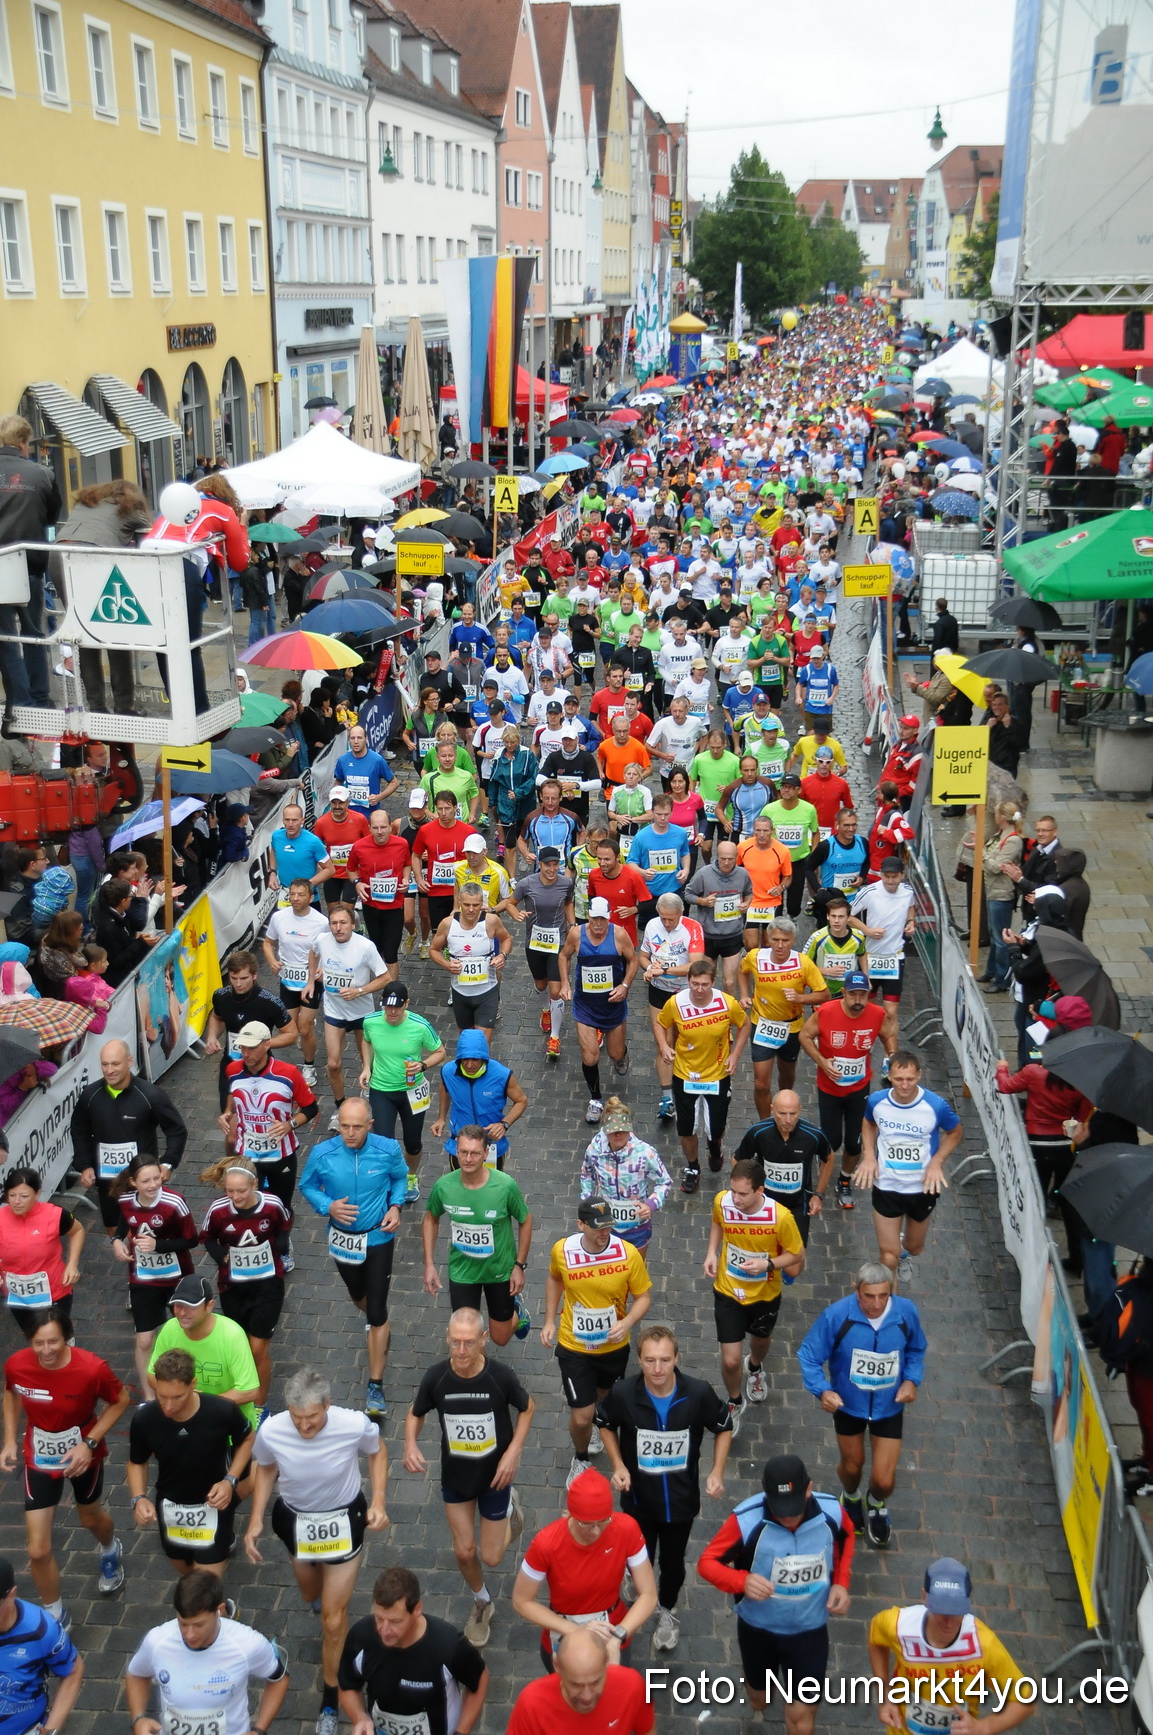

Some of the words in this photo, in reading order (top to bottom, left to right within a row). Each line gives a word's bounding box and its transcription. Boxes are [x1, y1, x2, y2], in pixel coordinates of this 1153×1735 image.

[671, 201, 683, 267] HOTEL
[500, 487, 513, 504] A
[860, 510, 874, 527] A
[400, 551, 441, 562] Schnupper-
[413, 560, 427, 568] lauf
[846, 574, 888, 585] Schnupper-
[860, 581, 874, 590] lauf
[628, 678, 640, 686] 249
[810, 693, 827, 701] 2777
[936, 748, 986, 763] Jugend-
[761, 766, 782, 775] 2831
[949, 762, 973, 774] lauf
[778, 832, 801, 840] 2028
[654, 856, 672, 865] 116
[373, 883, 395, 893] 2302
[723, 902, 735, 912] 53
[536, 932, 555, 944] 395
[463, 963, 483, 975] 481
[871, 959, 896, 969] 2903
[284, 968, 306, 981] 3089
[587, 972, 607, 983] 388
[780, 973, 804, 983] BÖGL
[326, 975, 353, 988] 2707
[682, 1021, 704, 1031] MAX
[706, 1014, 730, 1026] BÖGL
[759, 1022, 787, 1039] 2999
[835, 1063, 863, 1076] 2897
[244, 1113, 271, 1123] BIMBO
[247, 1138, 278, 1151] 2513
[103, 1151, 134, 1166] 2530
[887, 1148, 921, 1161] 3093
[767, 1169, 799, 1182] 2540
[456, 1229, 490, 1245] 2595
[724, 1226, 746, 1237] MAX
[748, 1225, 778, 1236] BÖGL
[331, 1231, 363, 1251] 2204
[140, 1253, 174, 1268] 3148
[234, 1251, 269, 1267] 3149
[568, 1270, 595, 1281] MAX
[598, 1264, 629, 1277] BÖGL
[9, 1281, 45, 1296] 3151
[576, 1316, 612, 1332] 3041
[856, 1360, 895, 1377] 2987
[455, 1425, 487, 1441] 263
[641, 1441, 685, 1457] 2847
[174, 1510, 208, 1527] 282
[306, 1521, 340, 1542] 360
[778, 1564, 823, 1585] 2350
[168, 1717, 221, 1735] 2243
[376, 1716, 423, 1735] 2528
